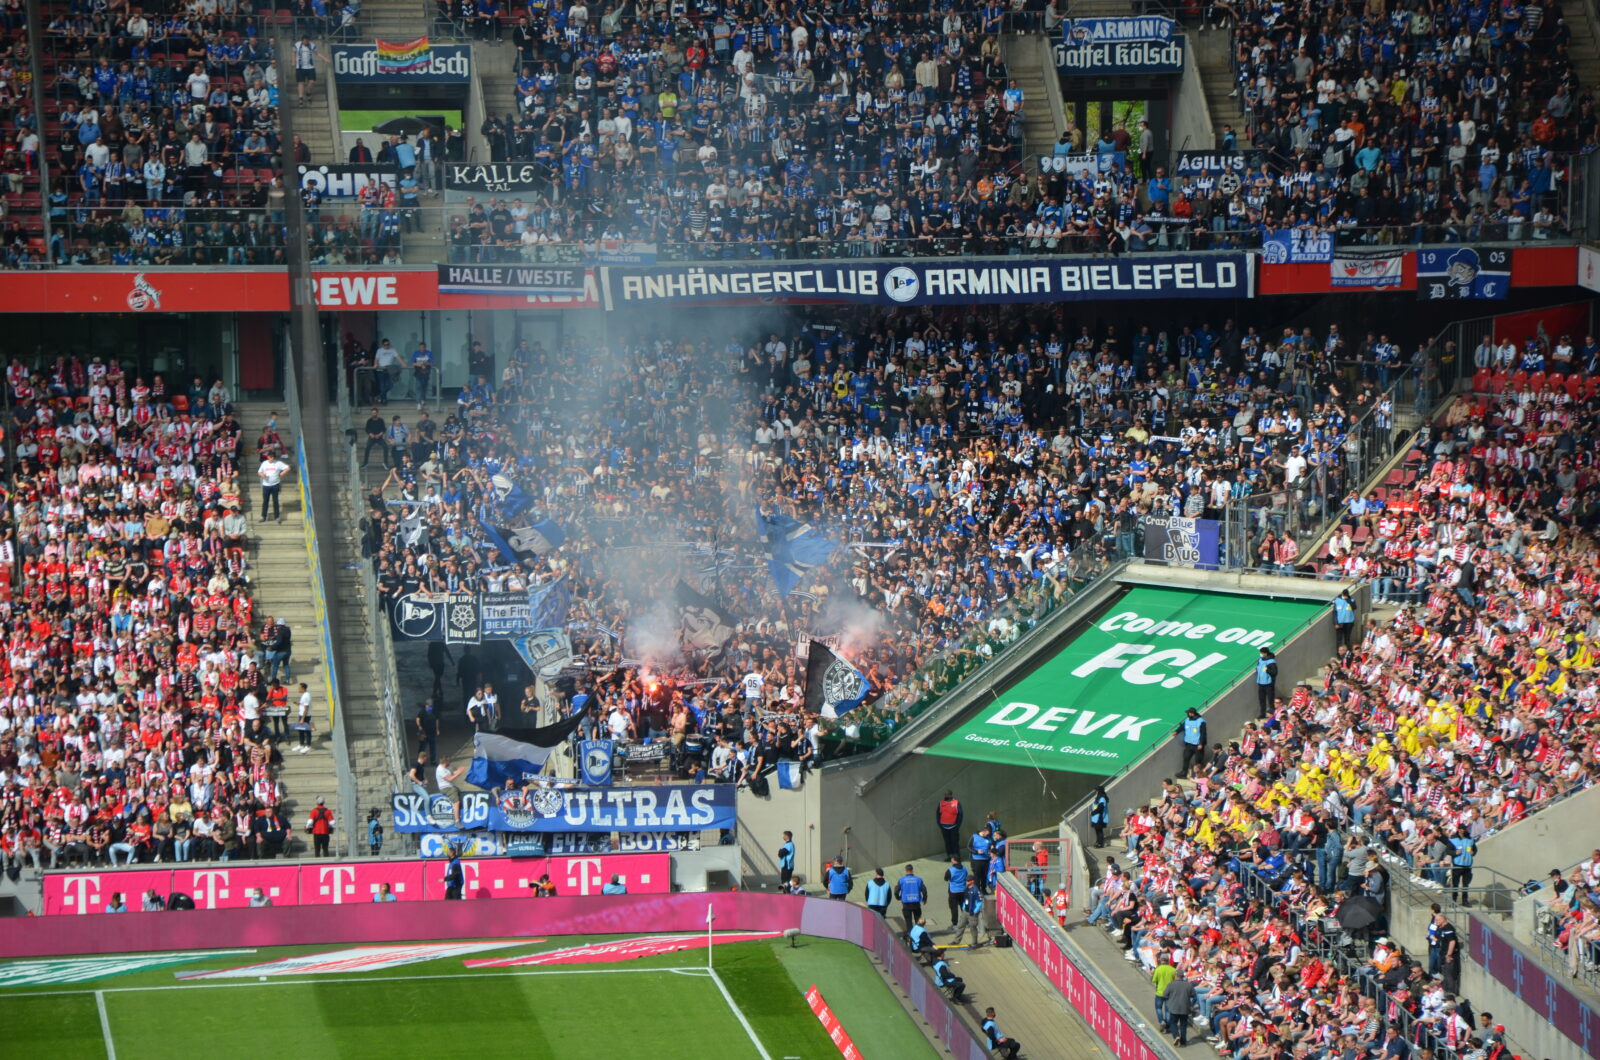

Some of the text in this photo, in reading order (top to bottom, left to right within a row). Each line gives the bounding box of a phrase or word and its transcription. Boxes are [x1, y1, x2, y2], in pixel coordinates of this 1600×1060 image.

[334, 50, 468, 78] Gaff lsch
[1116, 40, 1182, 68] Kölsch
[1178, 155, 1244, 171] ÁGILUS
[453, 165, 534, 184] KALLE
[485, 183, 511, 192] TAL
[1422, 252, 1506, 265] 19 05
[449, 267, 575, 286] HALLE / WESTF.
[622, 267, 879, 300] ANHÄNGERCLUB
[925, 262, 1237, 295] ARMINIA BIELEFELD
[1145, 515, 1193, 529] Crazy Blue
[485, 607, 506, 617] The
[1099, 611, 1276, 650] Come on,
[1070, 642, 1228, 689] FC!
[747, 678, 758, 689] 05
[984, 702, 1162, 742] DEVK
[585, 741, 609, 750] ULTRAS
[964, 733, 1120, 759] Gesagt. Getan. Geholfen.
[394, 793, 490, 826] SK 05
[563, 789, 715, 826] ULTRAS
[621, 832, 678, 851] BOYS
